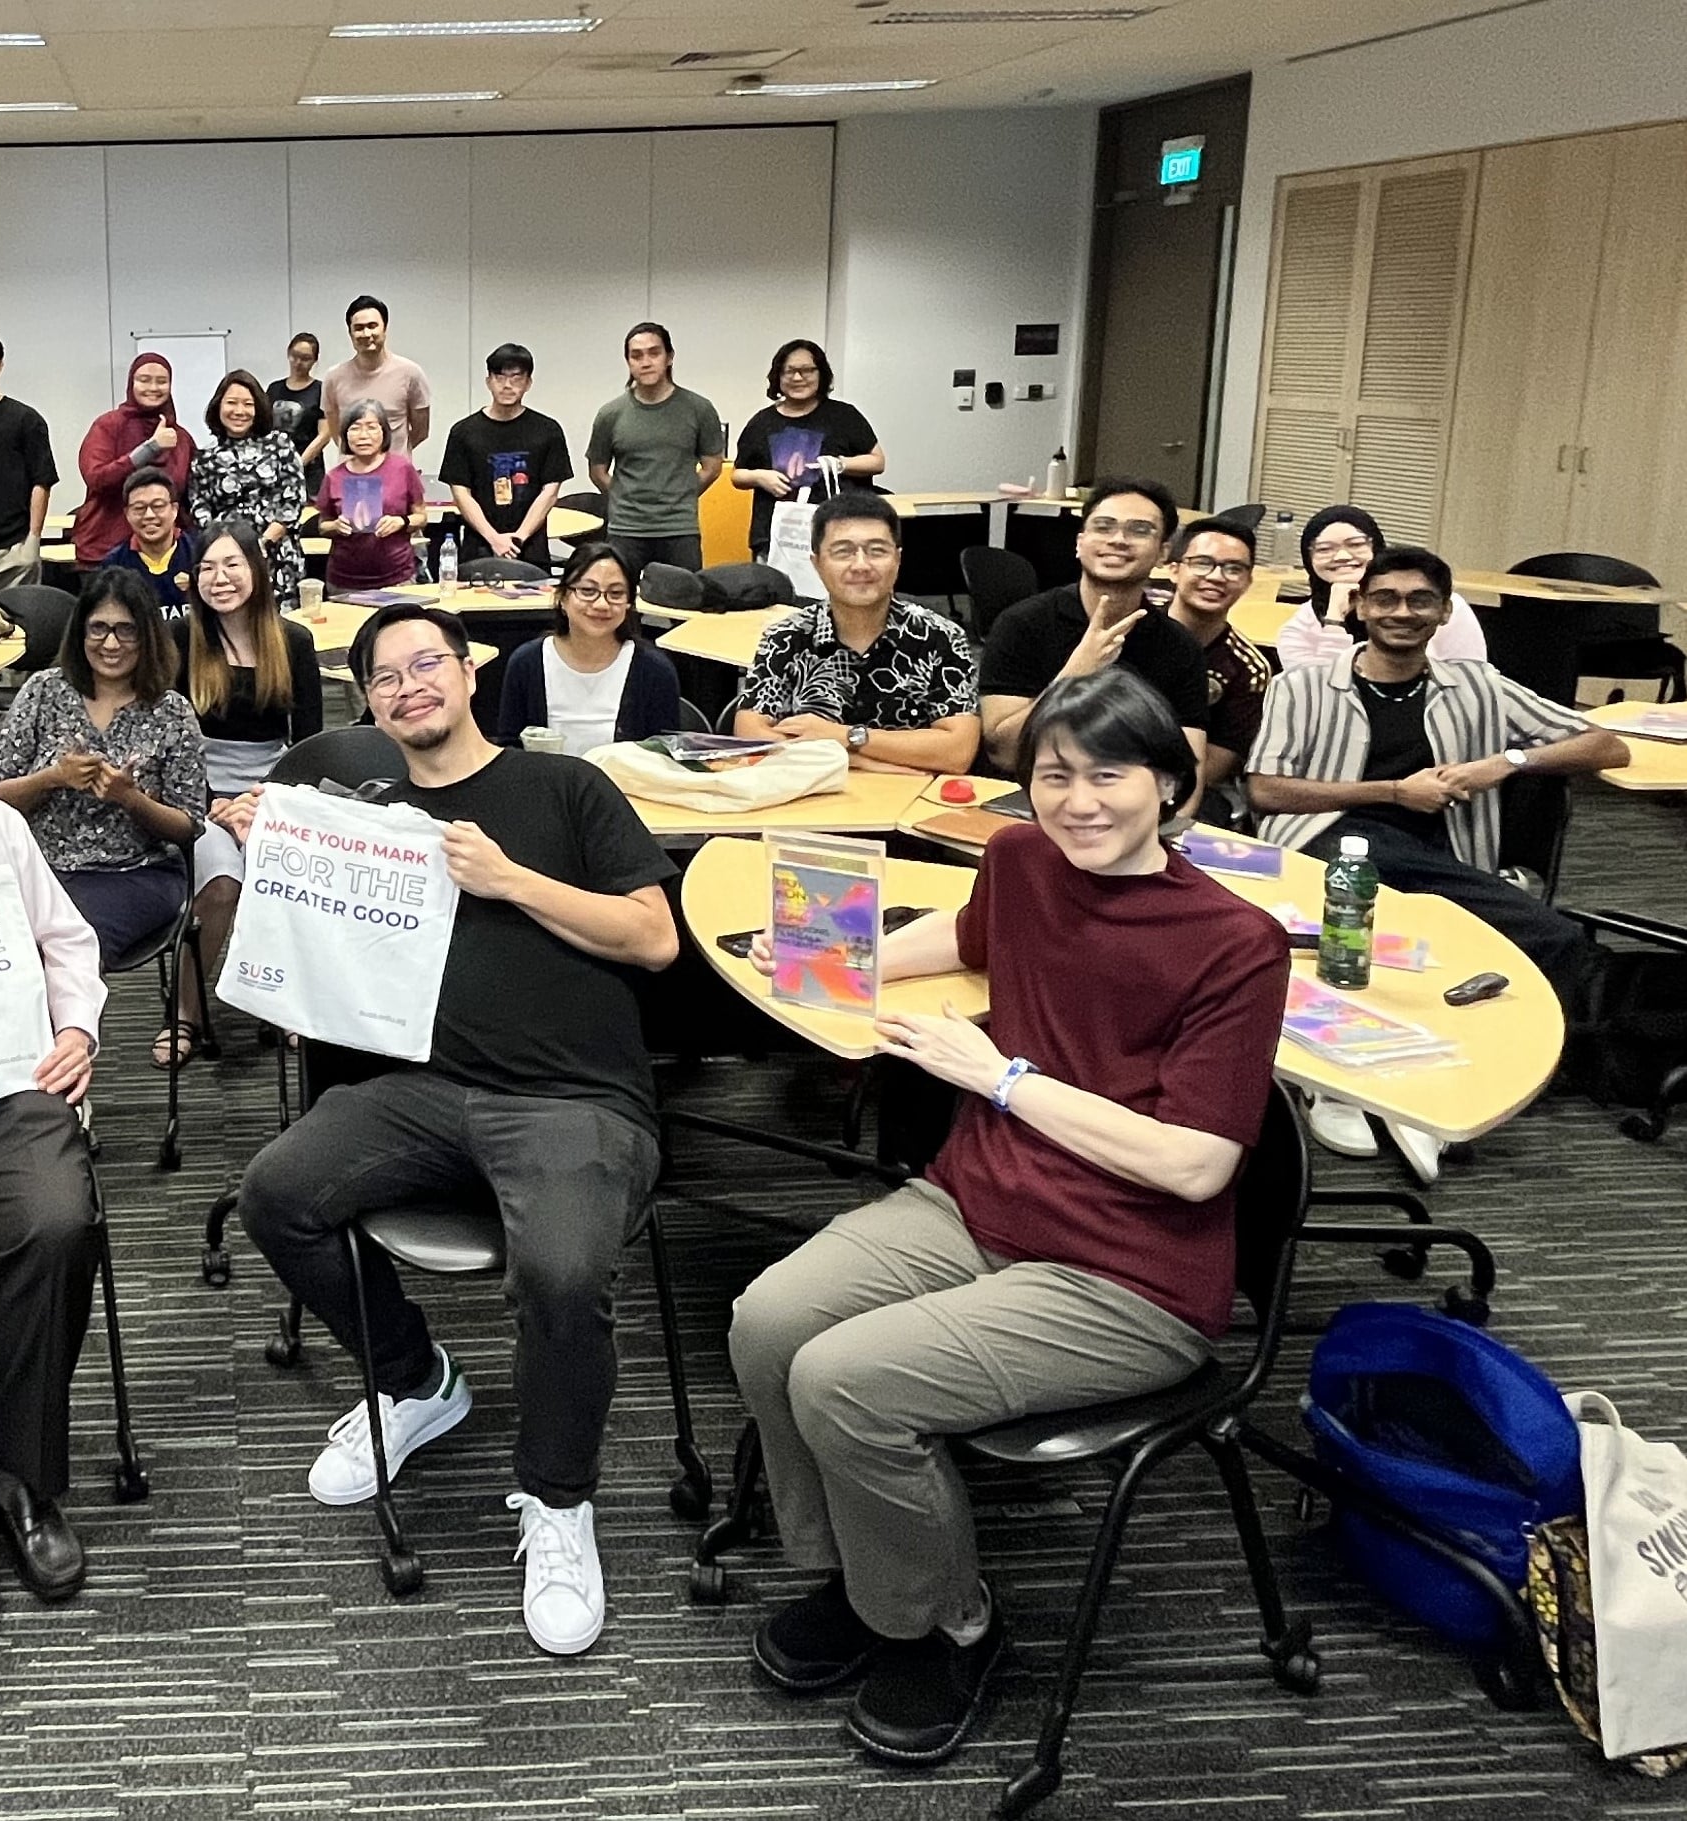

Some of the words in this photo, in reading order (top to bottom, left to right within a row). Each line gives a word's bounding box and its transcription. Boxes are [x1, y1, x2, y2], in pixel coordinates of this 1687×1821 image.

[1168, 156, 1192, 179] EXIT
[264, 819, 312, 843] MAKE
[316, 830, 367, 855] YOUR
[372, 843, 429, 867] MARK
[256, 840, 336, 889] FOR
[345, 862, 427, 907] THE
[254, 878, 347, 917] GREATER
[353, 905, 420, 931] GOOD
[238, 961, 285, 984] SUSS
